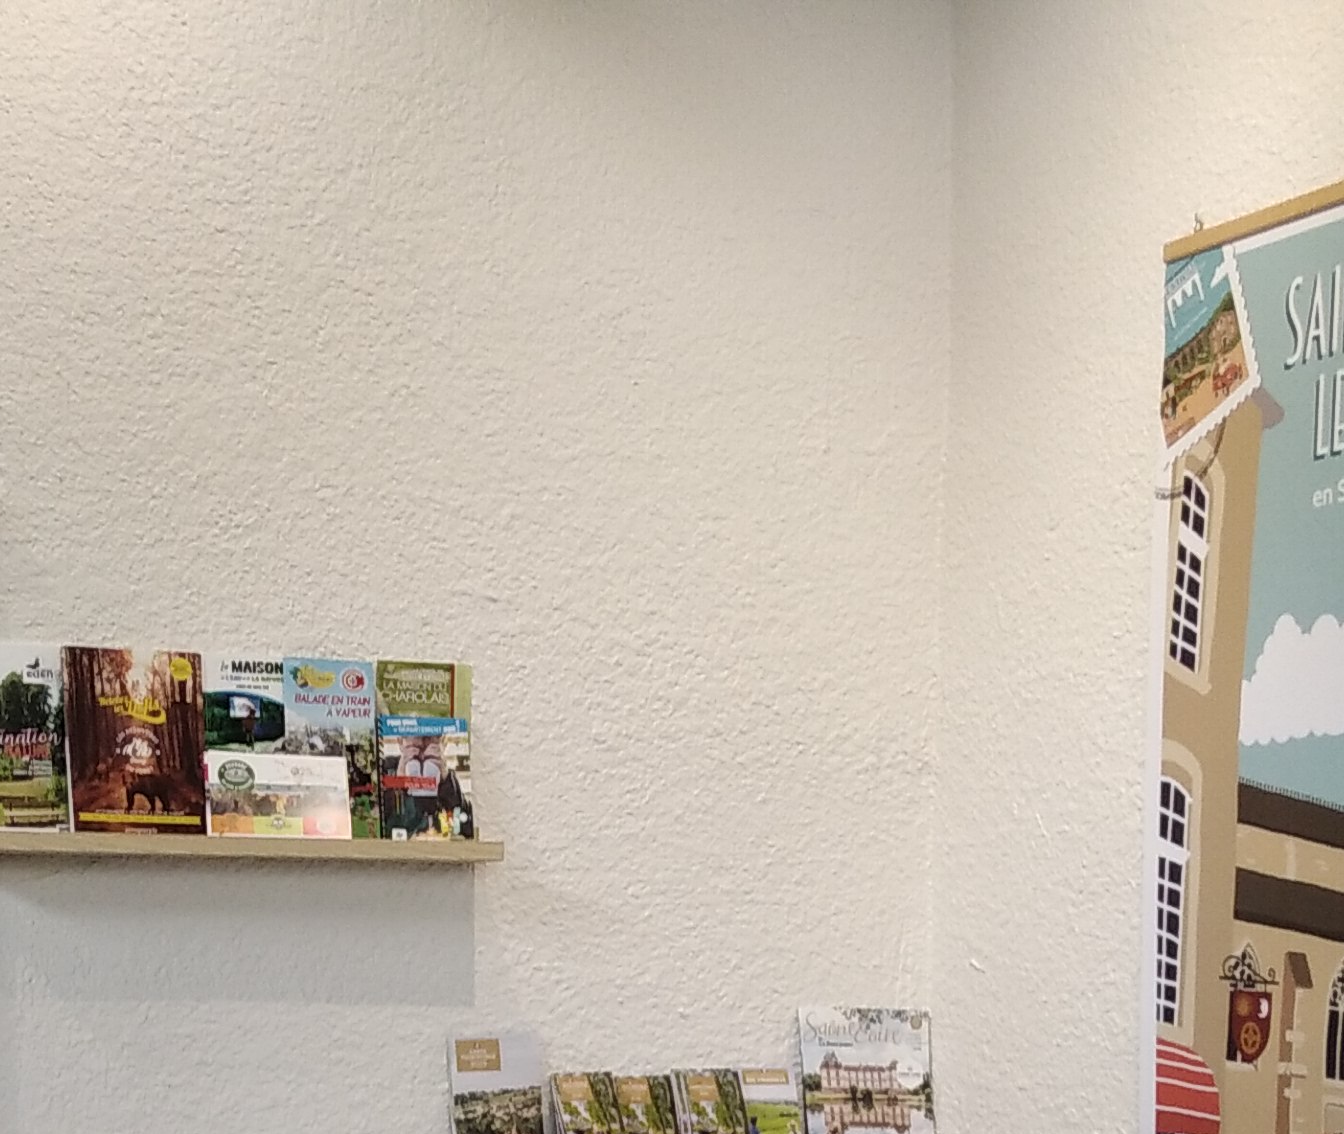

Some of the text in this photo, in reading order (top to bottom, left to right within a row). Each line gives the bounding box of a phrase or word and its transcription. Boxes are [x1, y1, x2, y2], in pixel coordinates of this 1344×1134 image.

[1312, 488, 1333, 507] en
[231, 661, 284, 674] MAISON
[294, 693, 371, 706] BALADE EN TRAIN
